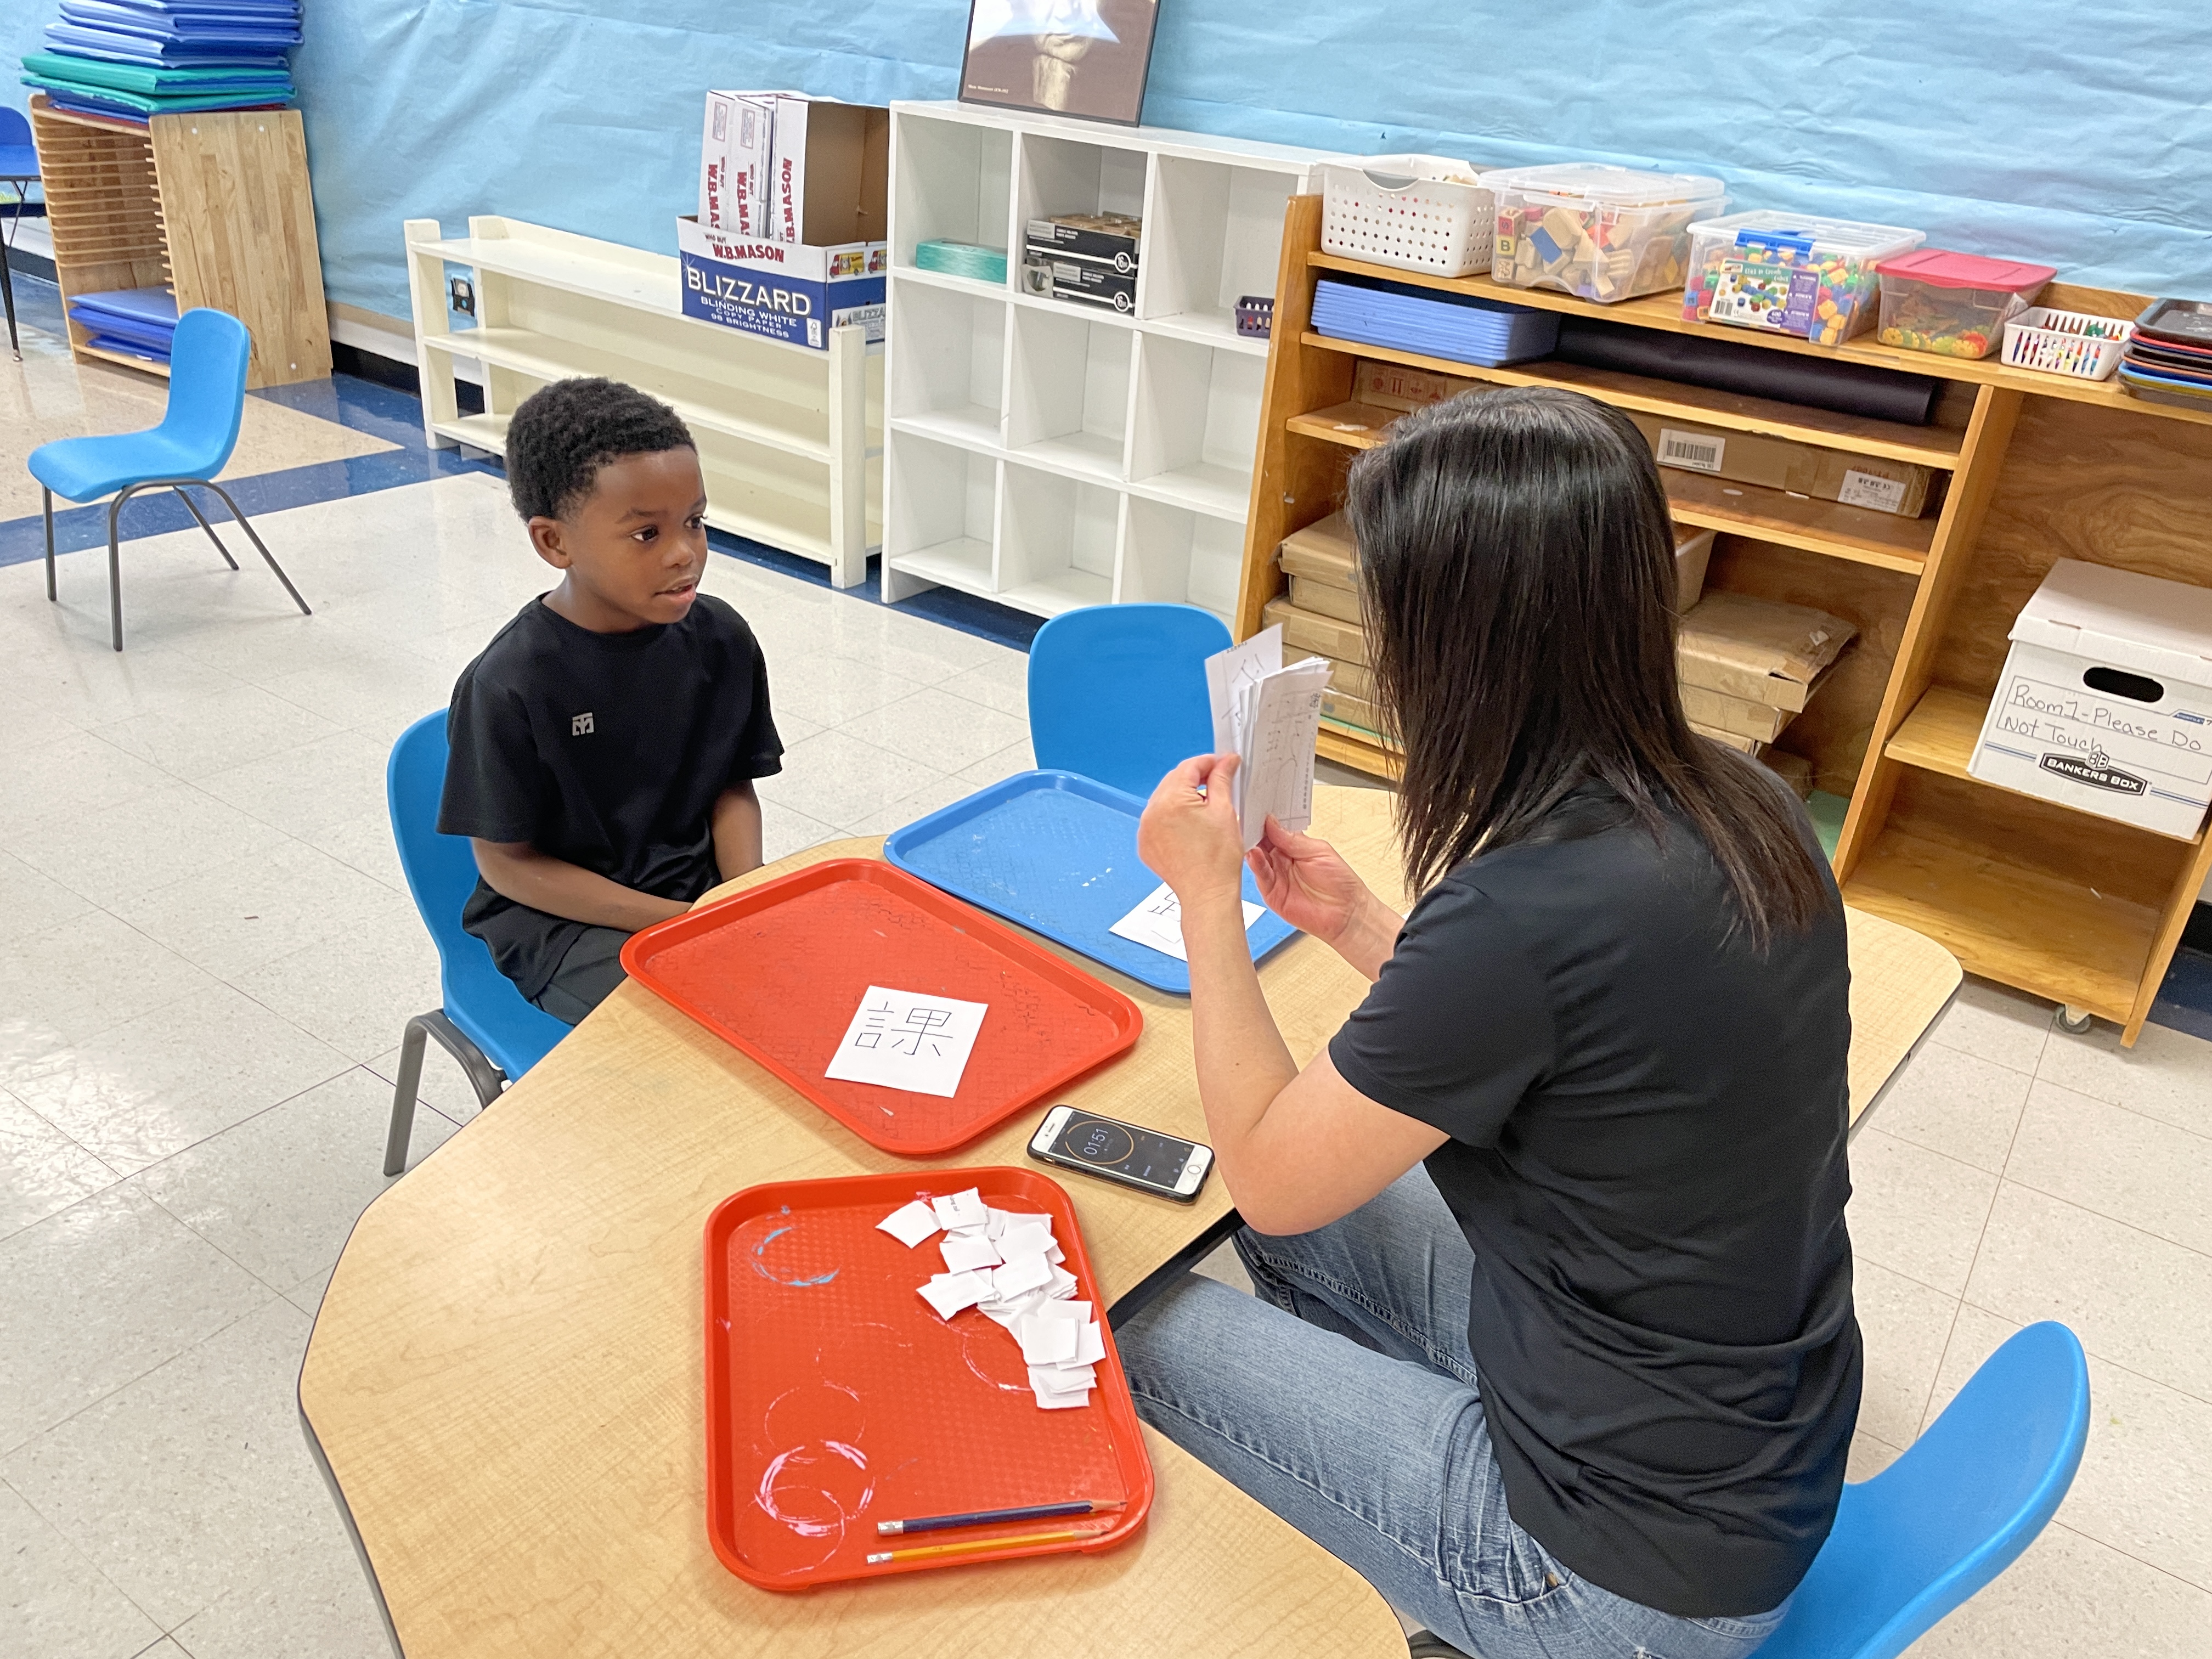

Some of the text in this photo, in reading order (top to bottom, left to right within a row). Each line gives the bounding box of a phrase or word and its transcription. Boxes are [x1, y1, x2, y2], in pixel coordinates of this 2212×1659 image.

[782, 157, 795, 244] .B.MASON
[712, 243, 785, 263] W.B.MASON
[1501, 240, 1510, 251] B
[687, 266, 811, 316] BLIZZARD
[701, 296, 797, 327] BLINDING WHITE
[716, 308, 782, 329] COPY PAPER
[711, 313, 789, 338] 98 BRIGHTNESS
[2005, 715, 2039, 738] Not
[2171, 730, 2202, 751] Do
[2047, 757, 2139, 791] BANKERS BOX
[1083, 1128, 1109, 1155] 01:51
